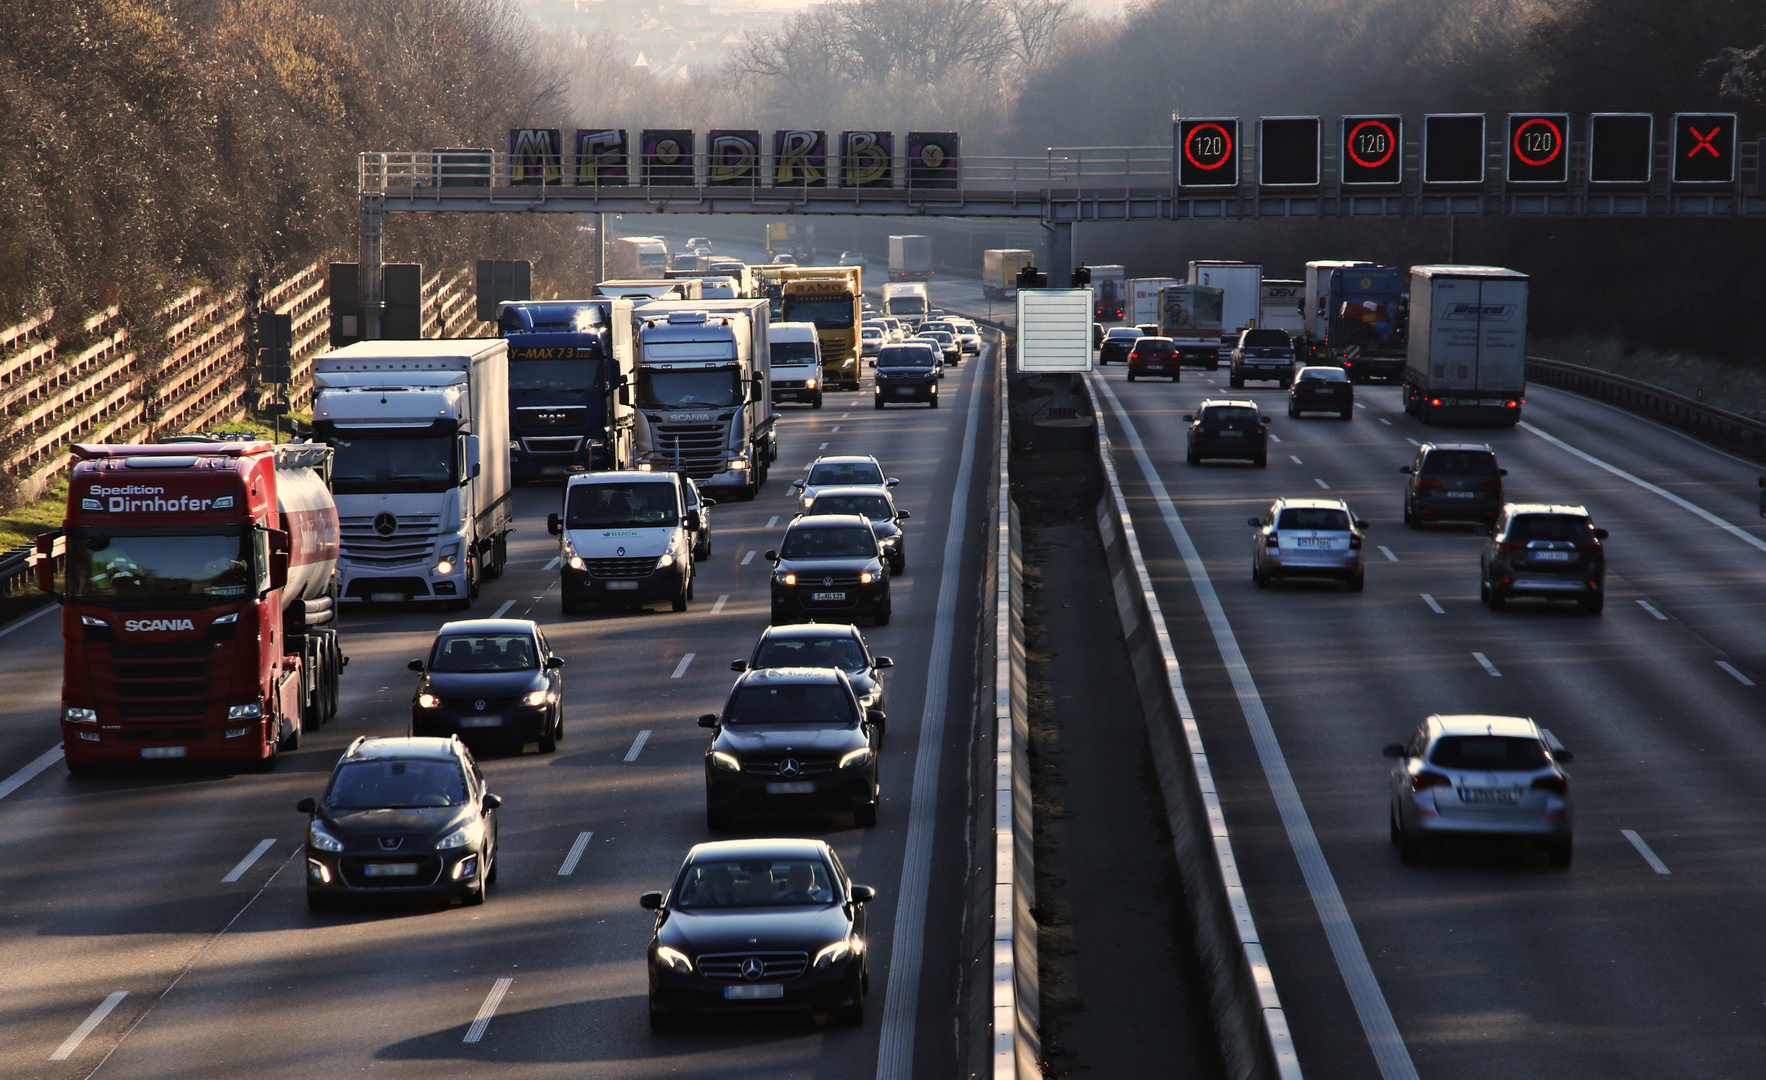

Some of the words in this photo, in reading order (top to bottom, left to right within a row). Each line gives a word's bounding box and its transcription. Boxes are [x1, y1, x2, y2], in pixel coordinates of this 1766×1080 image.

[1195, 136, 1222, 156] 120
[1359, 134, 1385, 153] 120
[1525, 132, 1552, 152] 120
[796, 284, 842, 293] RAMO
[1269, 288, 1297, 297] DSV
[1454, 304, 1505, 314] Wetzel
[557, 347, 574, 359] 73
[670, 413, 710, 423] SCANIA
[90, 485, 164, 496] Spedition
[108, 496, 212, 512] Dirnhofer
[125, 619, 194, 631] SCANIA
